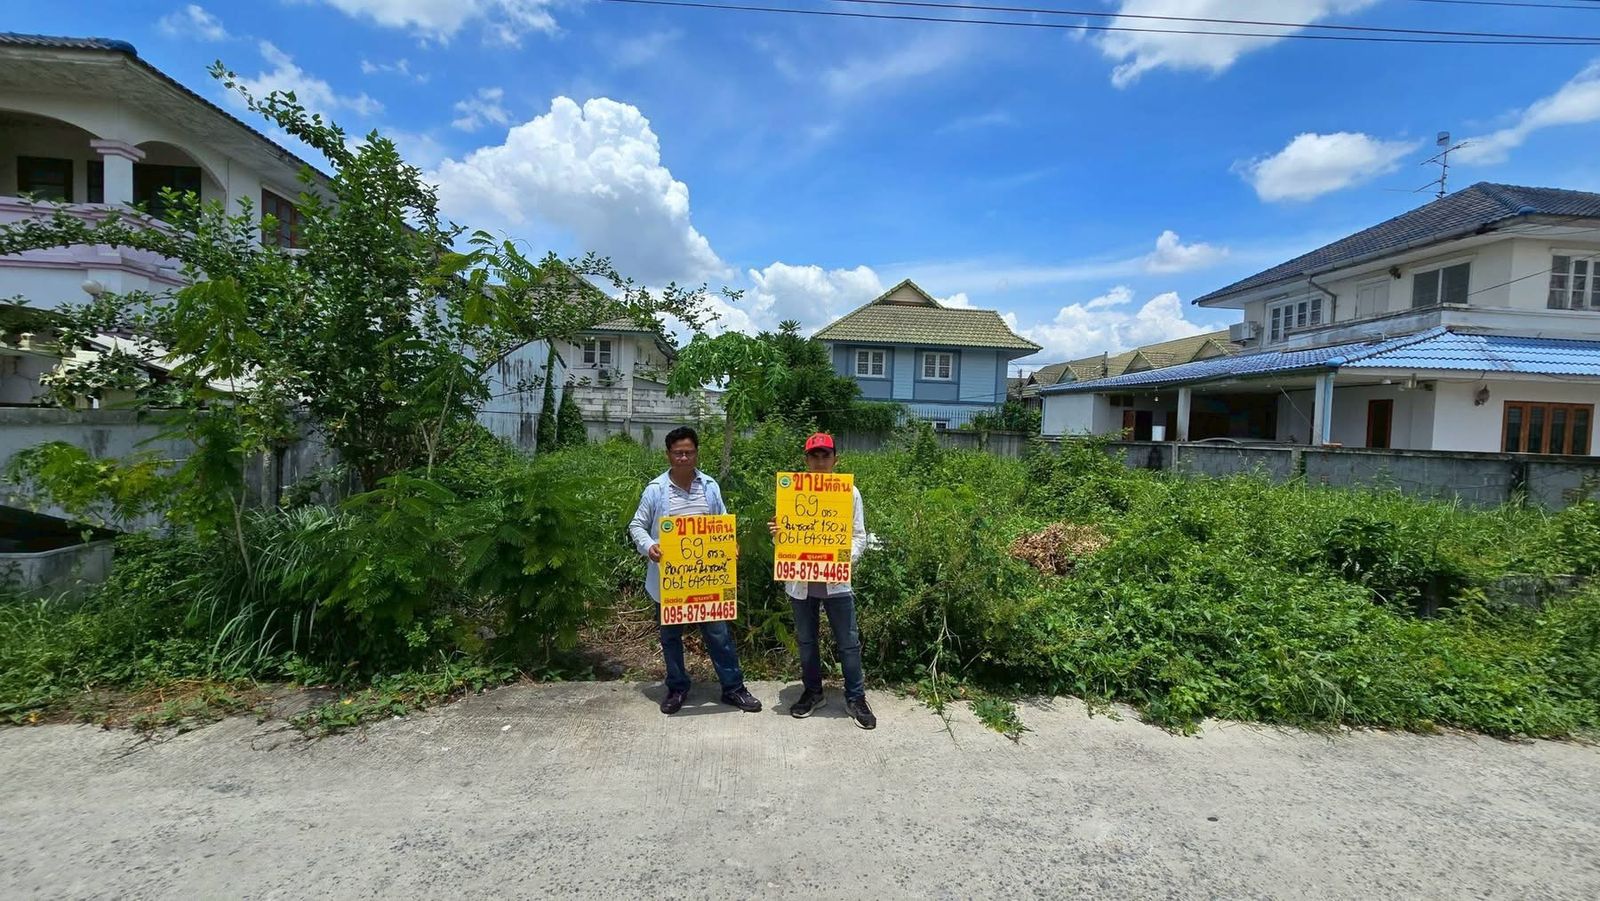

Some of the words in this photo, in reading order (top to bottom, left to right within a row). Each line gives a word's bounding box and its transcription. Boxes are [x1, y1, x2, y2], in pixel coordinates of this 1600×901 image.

[793, 474, 851, 492] ขายที่ดิน
[795, 493, 818, 516] 69
[676, 517, 734, 536] ขายที่ดิน
[821, 520, 838, 532] 150
[680, 537, 704, 560] 69
[776, 561, 849, 581] 095-879-4465
[663, 601, 735, 624] 095-879-4465
